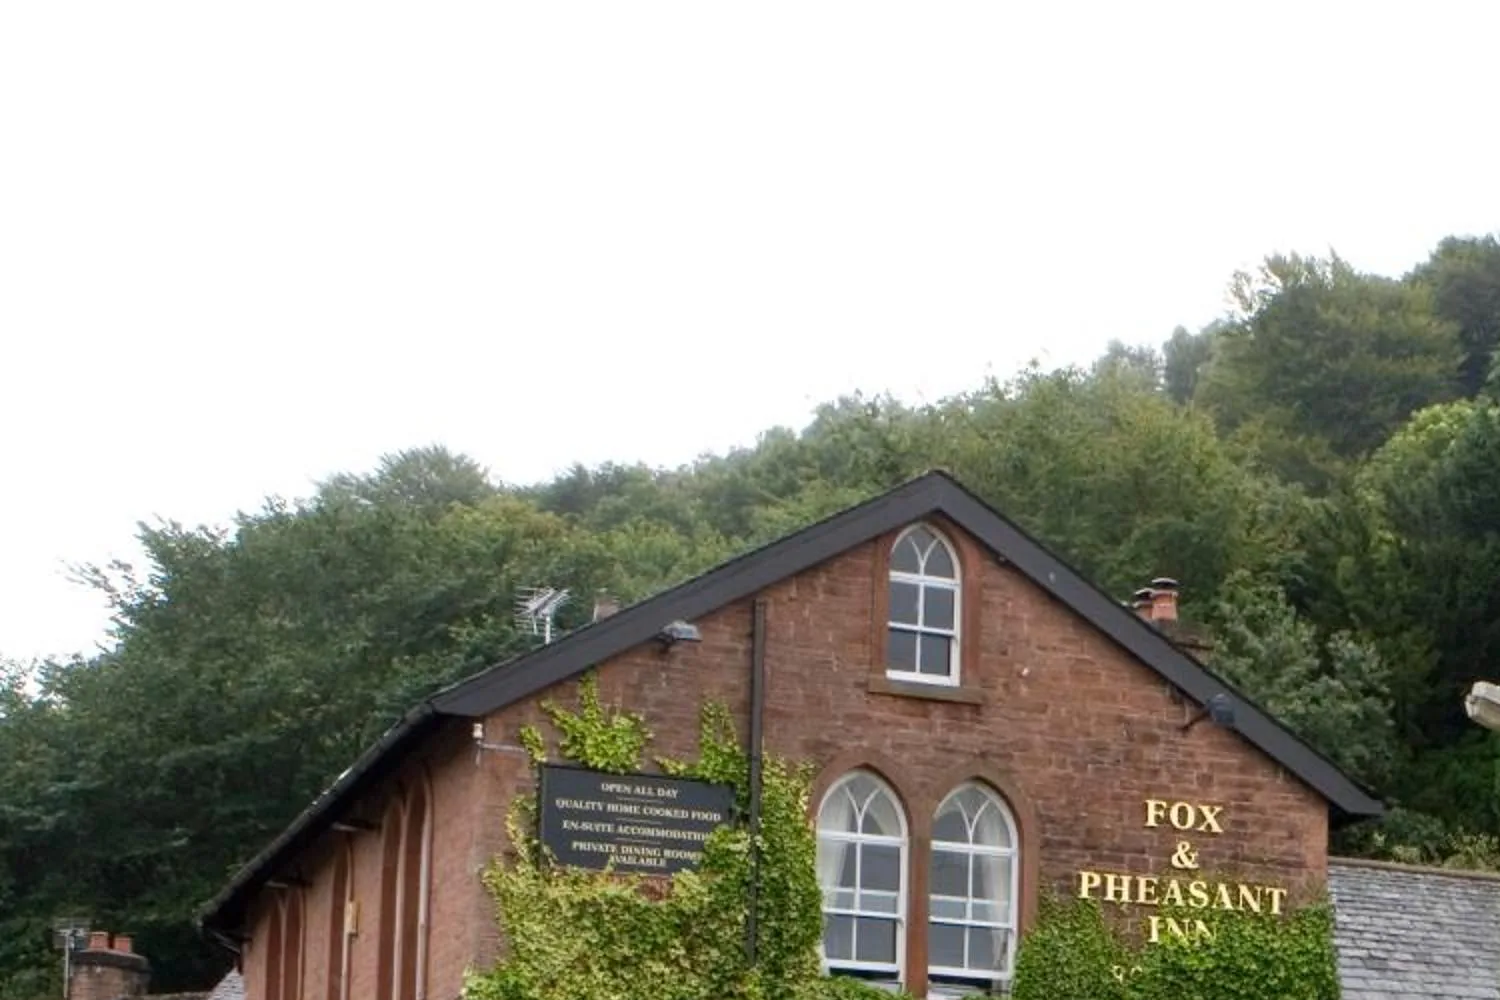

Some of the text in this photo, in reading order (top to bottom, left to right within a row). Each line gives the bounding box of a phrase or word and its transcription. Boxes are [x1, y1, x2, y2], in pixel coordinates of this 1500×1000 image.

[601, 783, 678, 798] OPEN ALL DAY
[555, 799, 721, 821] QUALITY HOME COOKED FOOD
[1145, 799, 1223, 833] FOX
[563, 819, 706, 841] EN-SUITE ACCOMMODATI
[572, 841, 618, 853] PRIVATE
[621, 845, 661, 857] DINING
[1171, 841, 1200, 869] &
[1078, 871, 1287, 915] PHEASANT
[1147, 915, 1218, 945] INN
